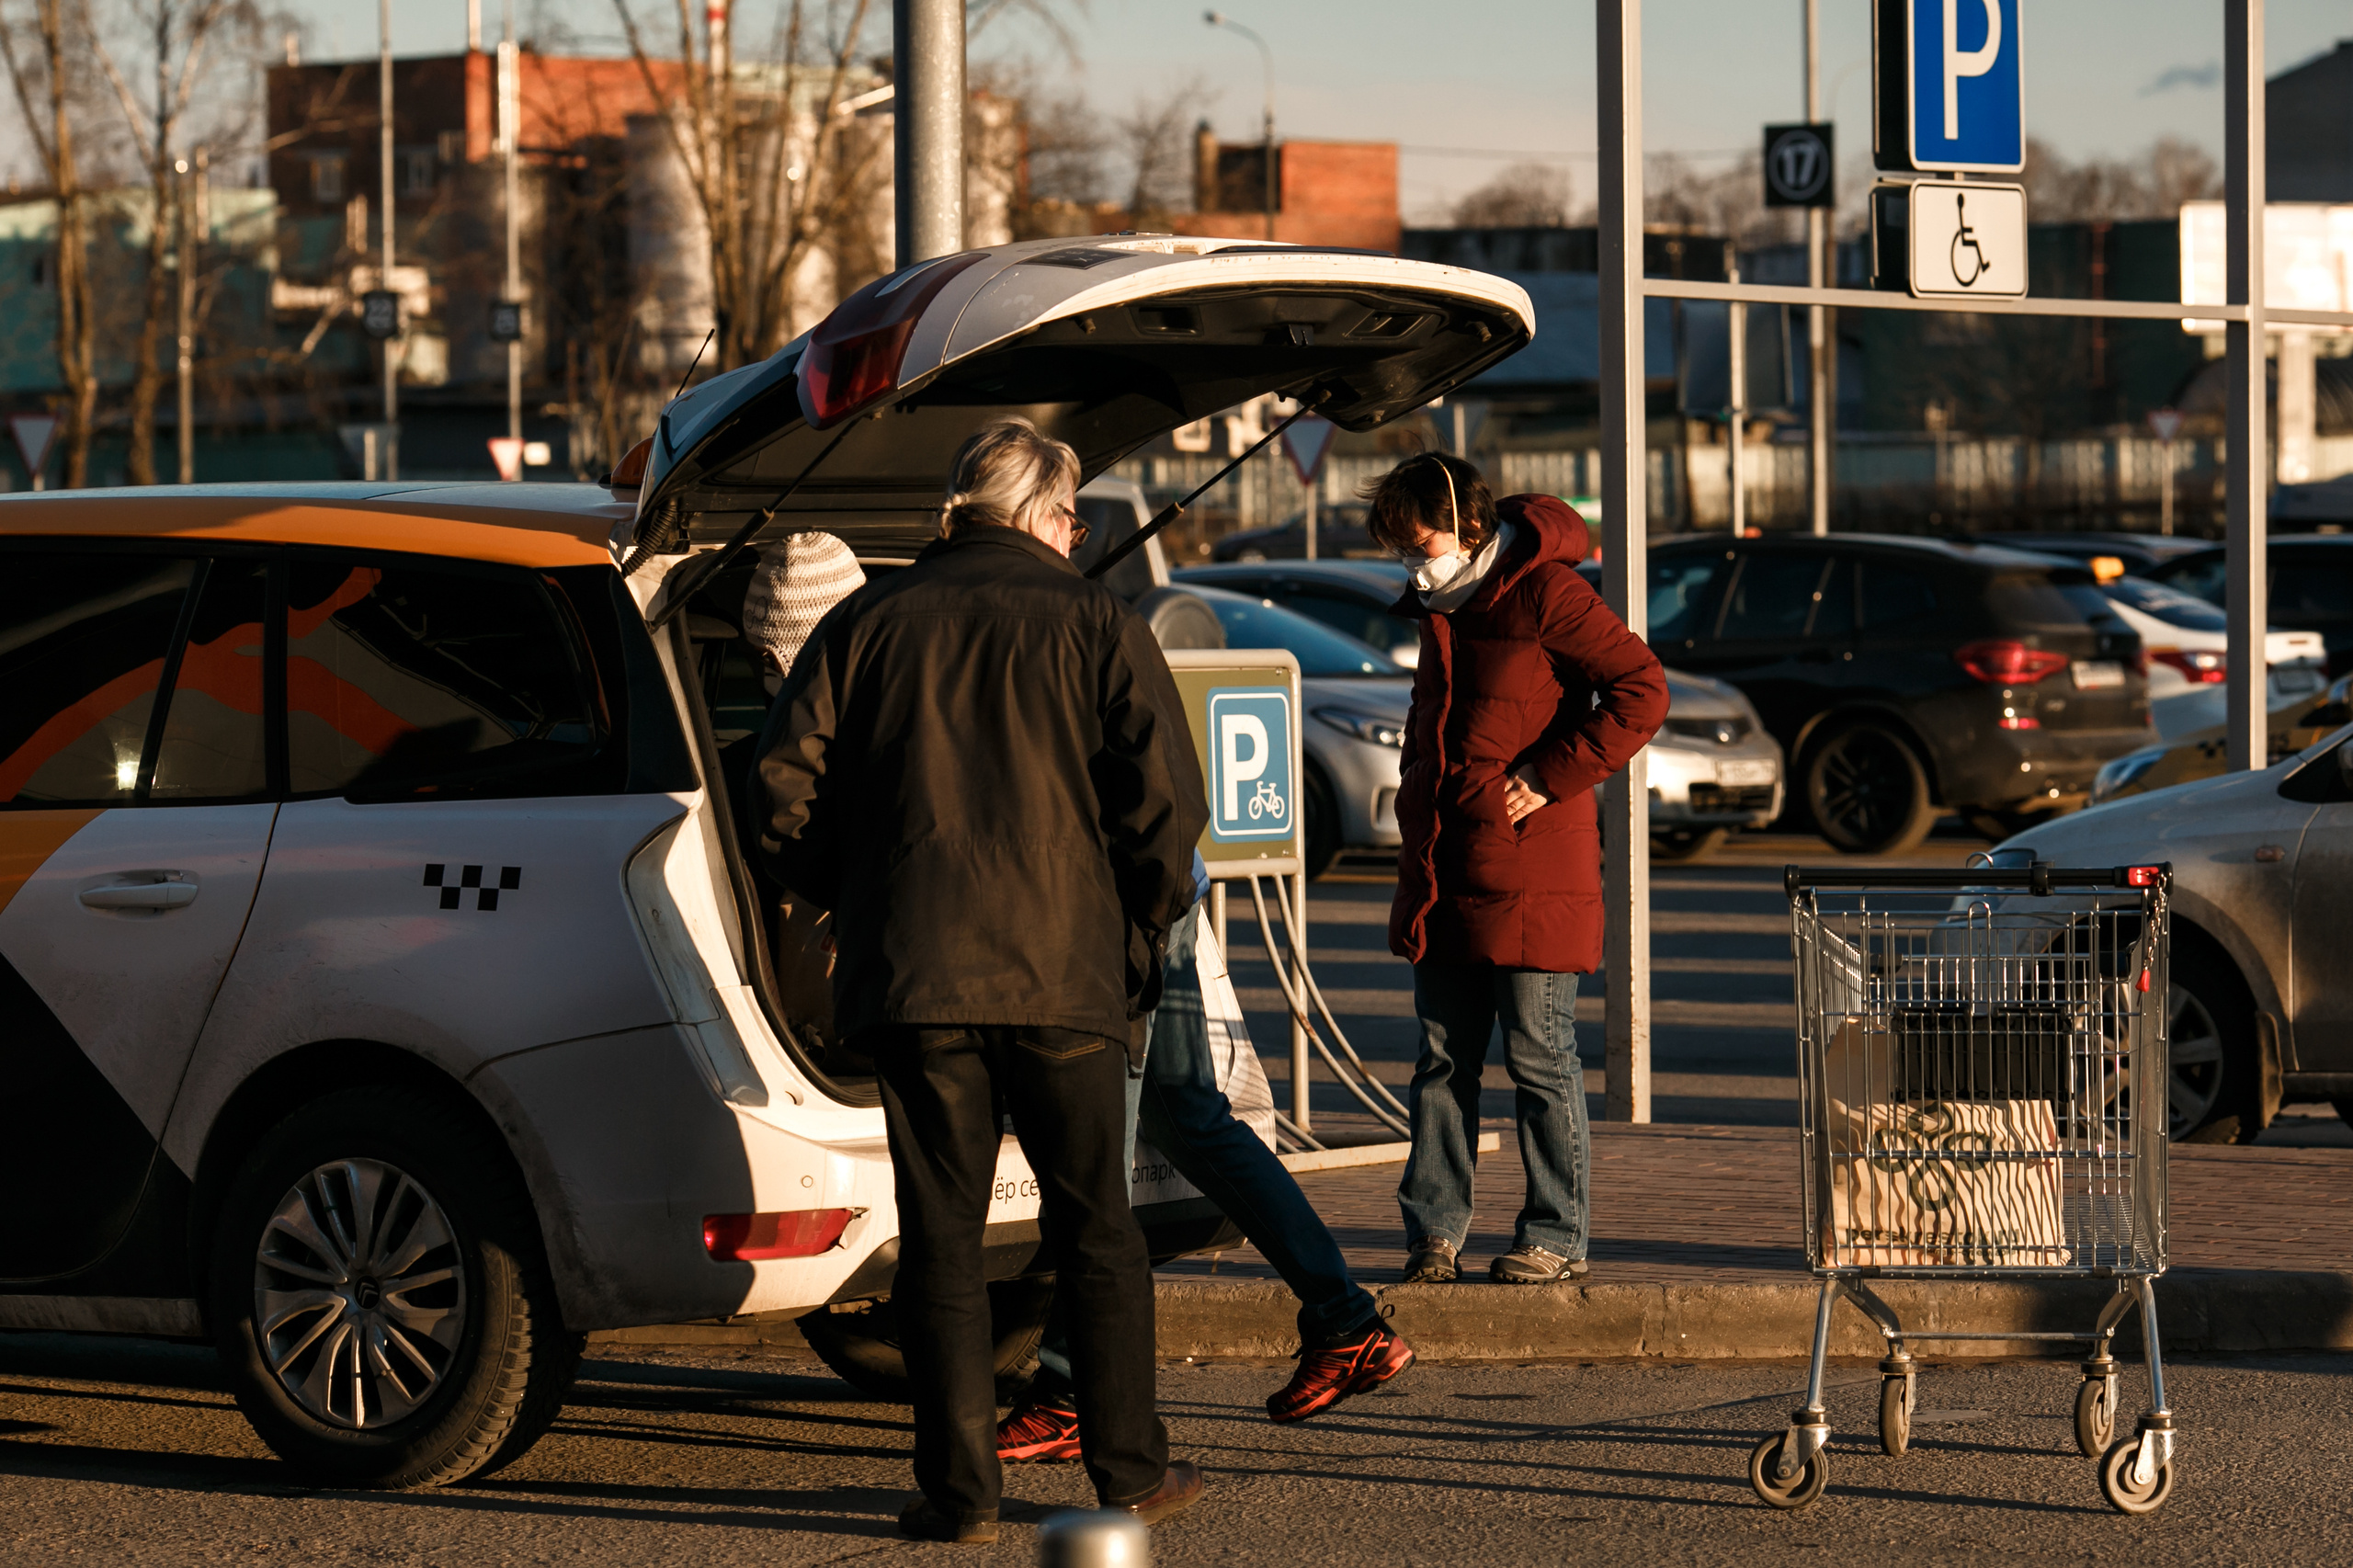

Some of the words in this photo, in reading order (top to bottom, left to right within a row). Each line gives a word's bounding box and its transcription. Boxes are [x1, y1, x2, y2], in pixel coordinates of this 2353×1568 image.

[1943, 0, 2002, 141] P
[1780, 144, 1817, 186] 17
[1222, 714, 1268, 821] P
[991, 1176, 1016, 1204] ёр
[1020, 1178, 1041, 1200] се
[1131, 1163, 1176, 1186] опарк
